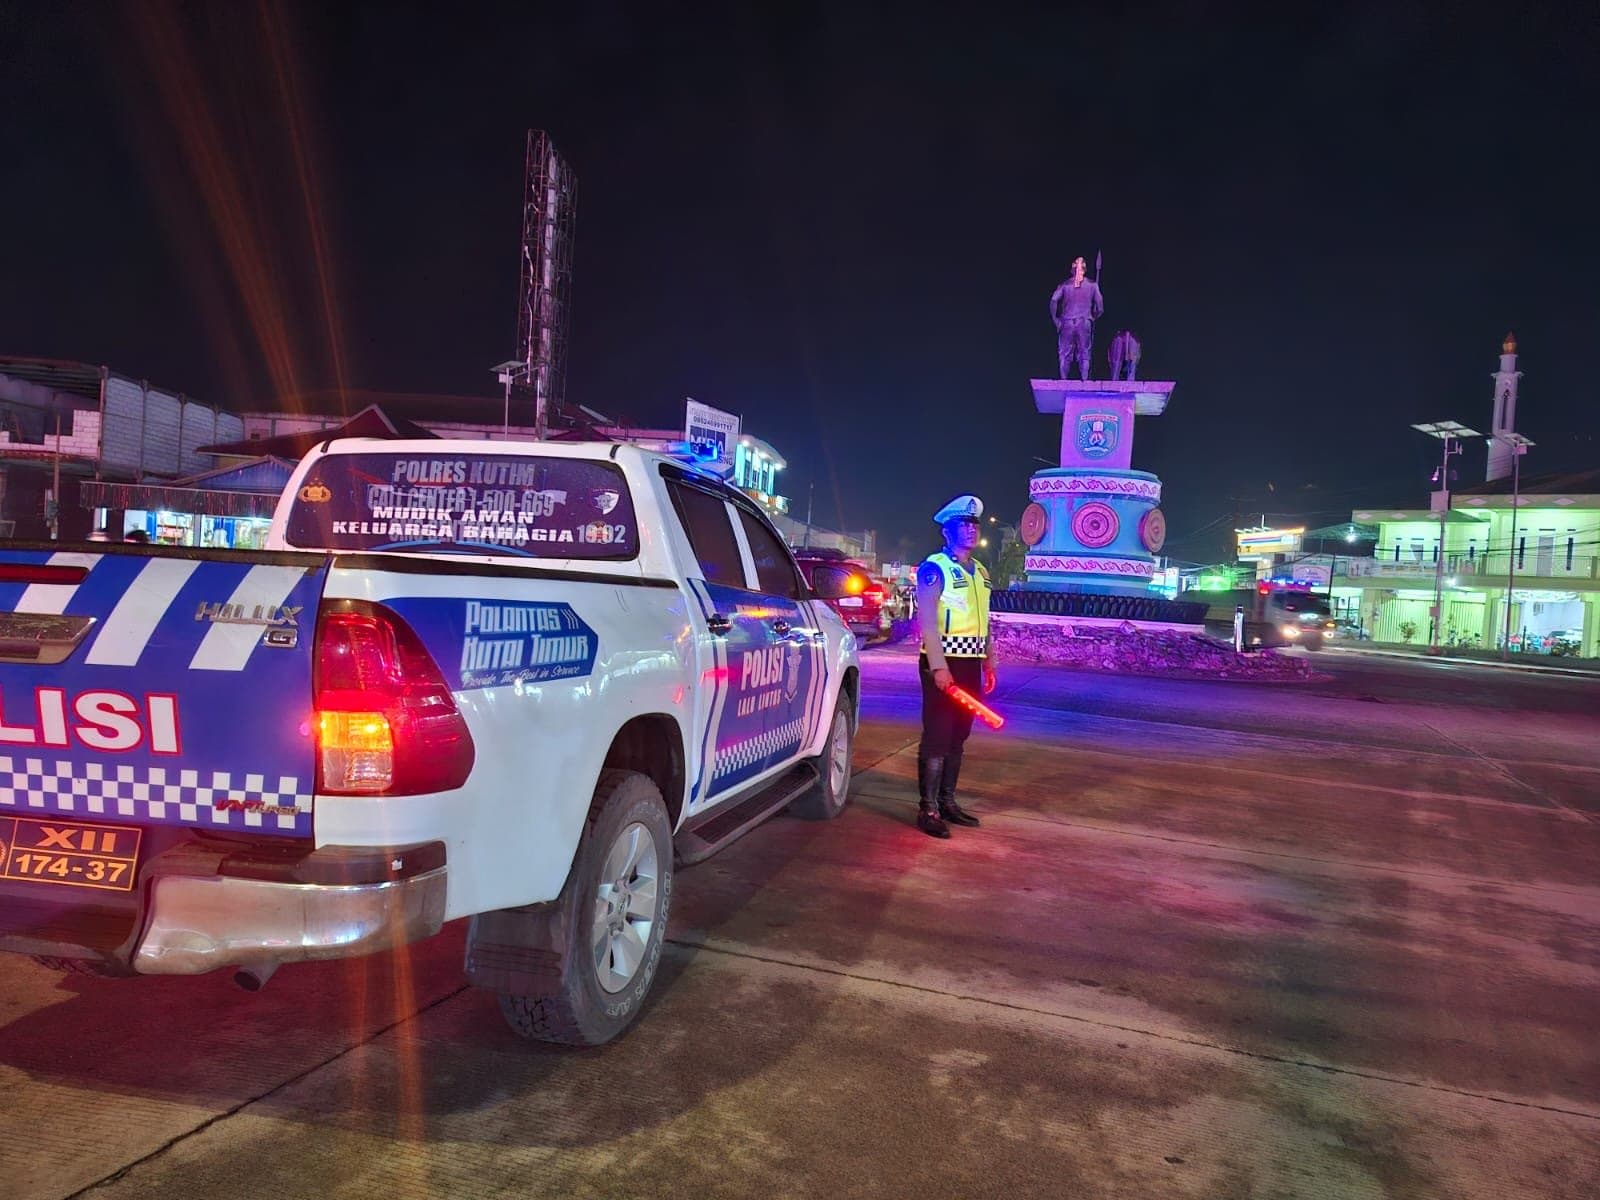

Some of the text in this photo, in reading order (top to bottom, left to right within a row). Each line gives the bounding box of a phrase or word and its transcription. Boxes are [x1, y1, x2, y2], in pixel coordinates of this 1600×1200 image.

[394, 460, 466, 484] POLRES
[411, 487, 465, 514] CENTER
[373, 506, 535, 524] MUDIK AMAN
[332, 520, 454, 538] KELUARGA
[463, 526, 574, 543] BAHAGIA
[194, 601, 304, 625] HILUX
[741, 647, 785, 691] POLISI
[35, 826, 117, 853] XII
[15, 854, 128, 882] 174-37
